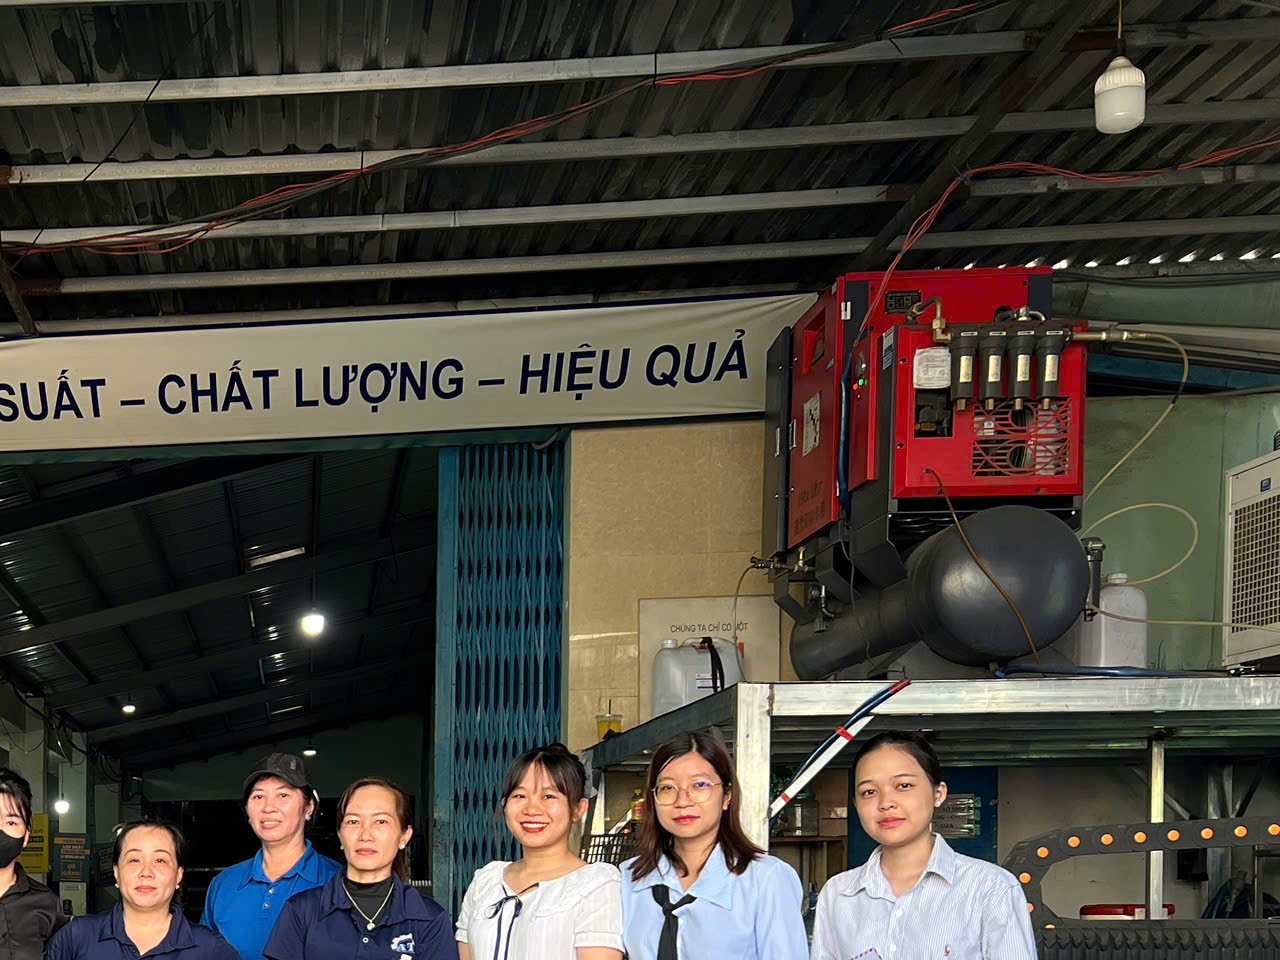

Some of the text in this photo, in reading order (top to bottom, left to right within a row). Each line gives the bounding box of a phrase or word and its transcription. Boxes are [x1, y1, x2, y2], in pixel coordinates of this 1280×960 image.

[158, 359, 279, 415] CHẤT
[294, 358, 465, 413] LƯỢNG
[519, 343, 631, 401] HIỆU
[645, 328, 749, 387] QUẢ
[670, 623, 696, 633] CHÚNG
[697, 623, 708, 632] TA
[721, 622, 732, 632] CÓ
